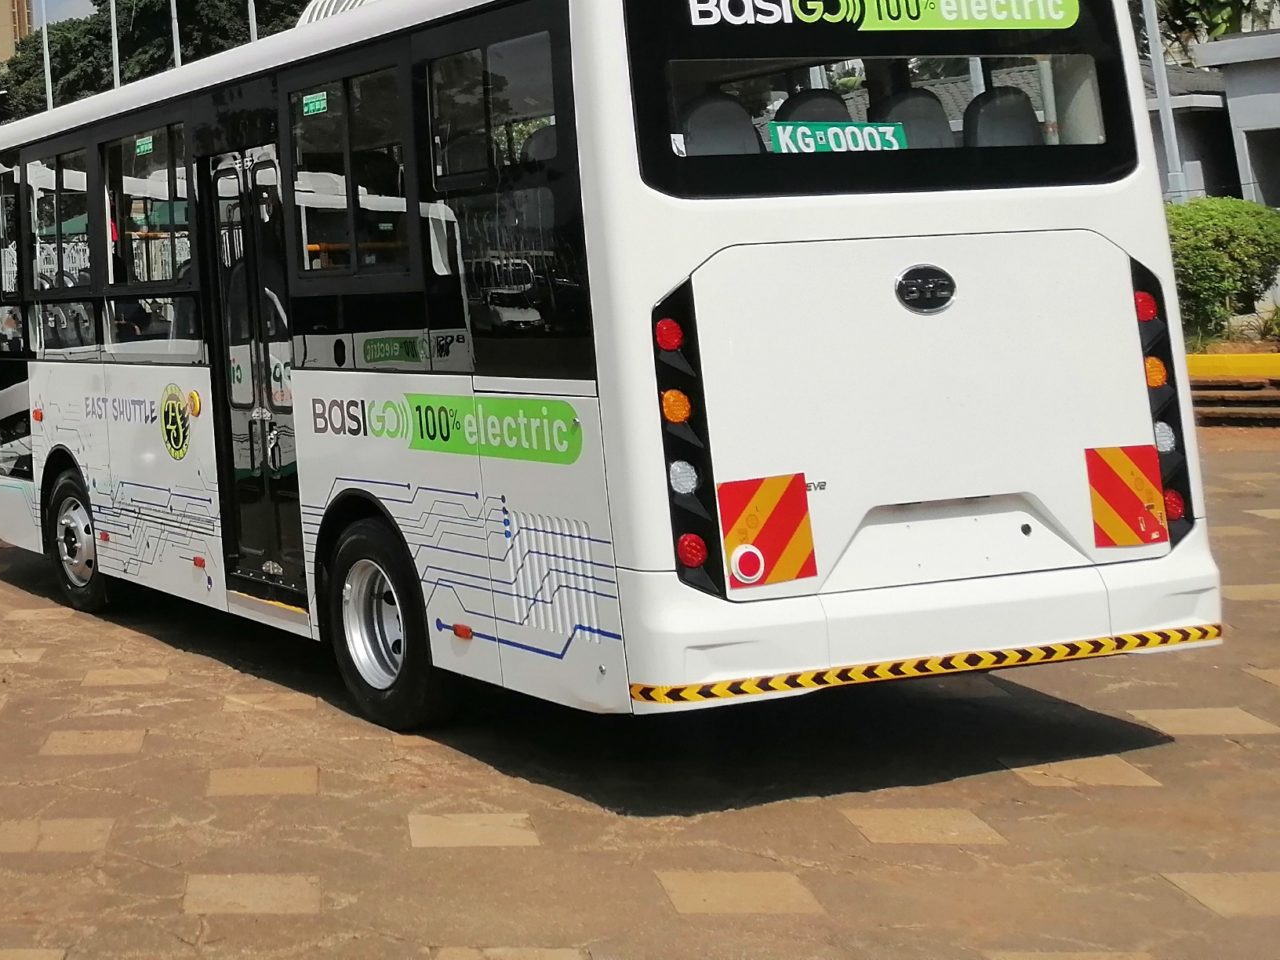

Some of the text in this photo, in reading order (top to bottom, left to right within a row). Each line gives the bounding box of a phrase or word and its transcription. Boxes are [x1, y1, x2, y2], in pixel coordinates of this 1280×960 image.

[84, 396, 158, 424] EAST SHUTTLE
[415, 404, 462, 442] 100%
[464, 403, 570, 452] electric
